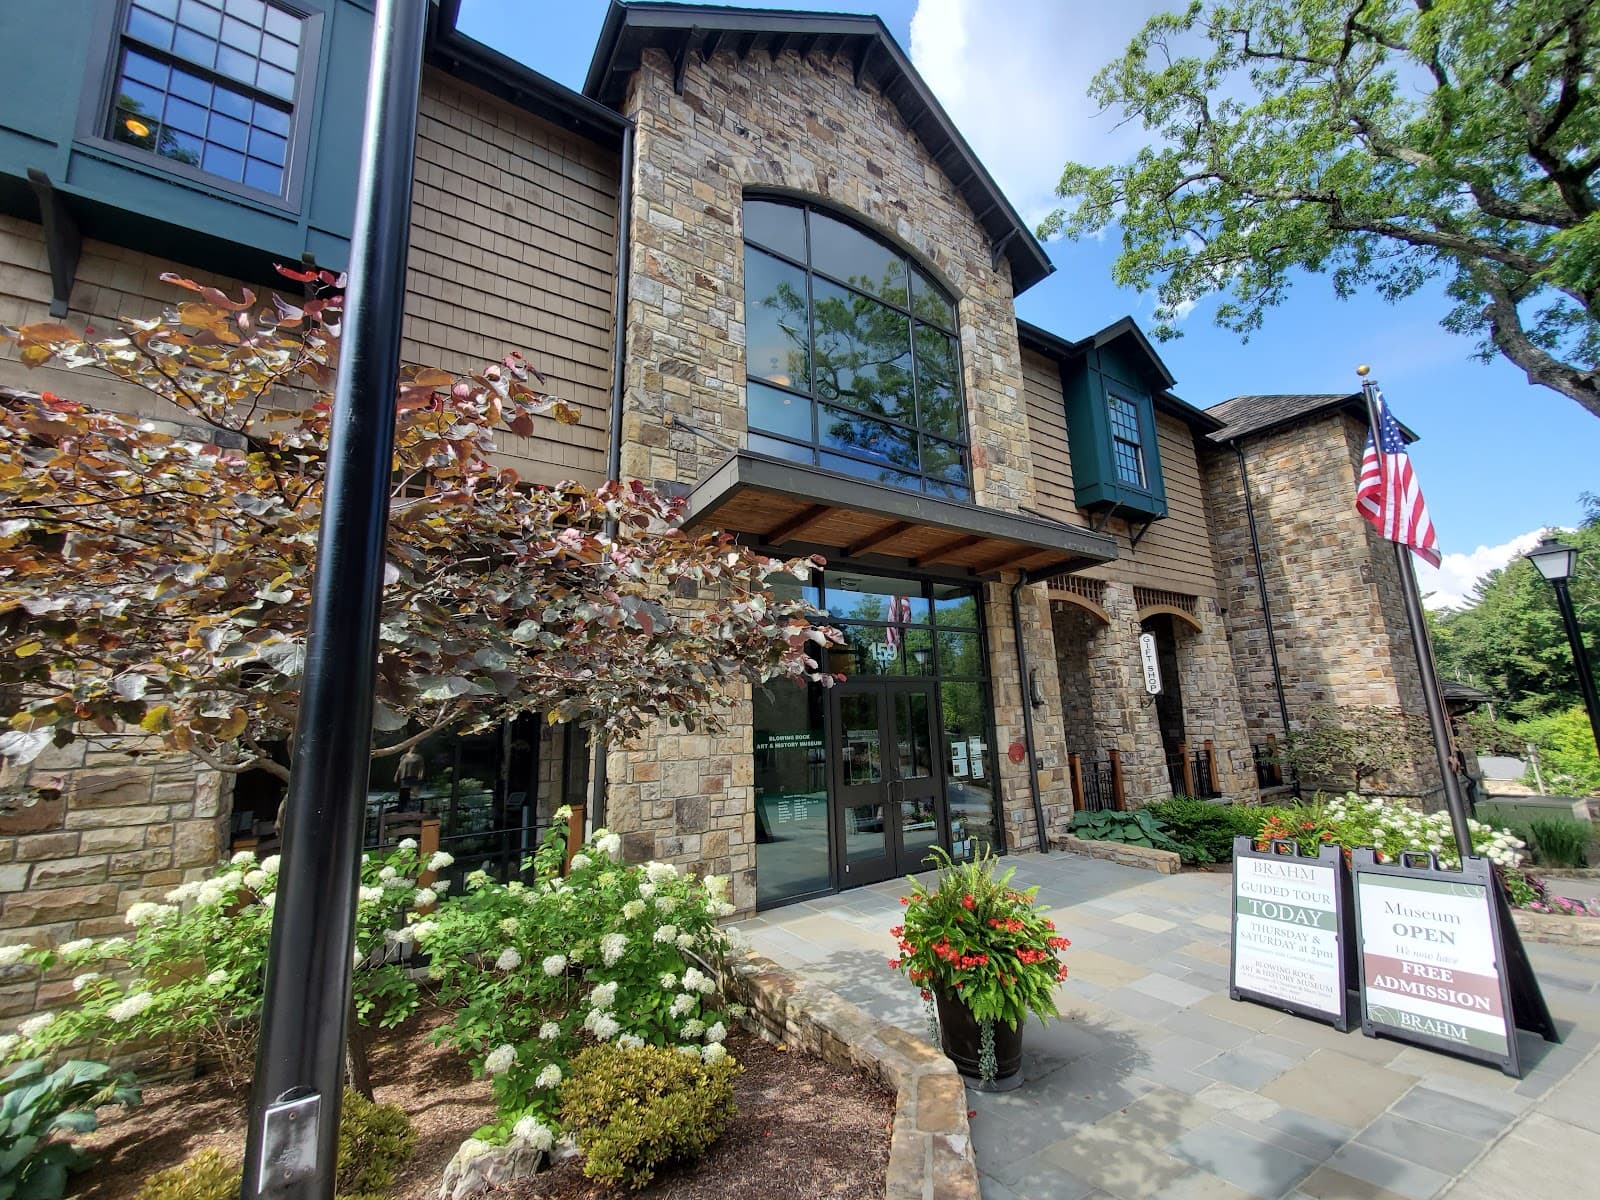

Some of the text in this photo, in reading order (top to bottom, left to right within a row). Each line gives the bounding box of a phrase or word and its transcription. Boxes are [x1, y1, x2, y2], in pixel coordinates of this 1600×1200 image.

[868, 641, 897, 661] 159
[1143, 636, 1157, 691] GIFT SHOP
[1253, 861, 1315, 880] BRAHM
[1241, 881, 1331, 905] GUIDED TOUR
[1248, 899, 1323, 928] TODAY
[1384, 901, 1461, 925] Museum
[1240, 931, 1297, 951] SATURDAY
[1298, 945, 1308, 954] at
[1311, 945, 1333, 959] 2pm
[1251, 921, 1321, 945] THURSDAY &
[1392, 923, 1455, 945] OPEN
[1413, 951, 1434, 960] now
[1255, 960, 1291, 976] BLOWING
[1401, 961, 1454, 983] FREE
[1262, 969, 1294, 984] HISTORY
[1296, 979, 1333, 993] MUSEUM
[1373, 974, 1490, 1011] ADMISSION
[1400, 1012, 1468, 1040] BRAHM
